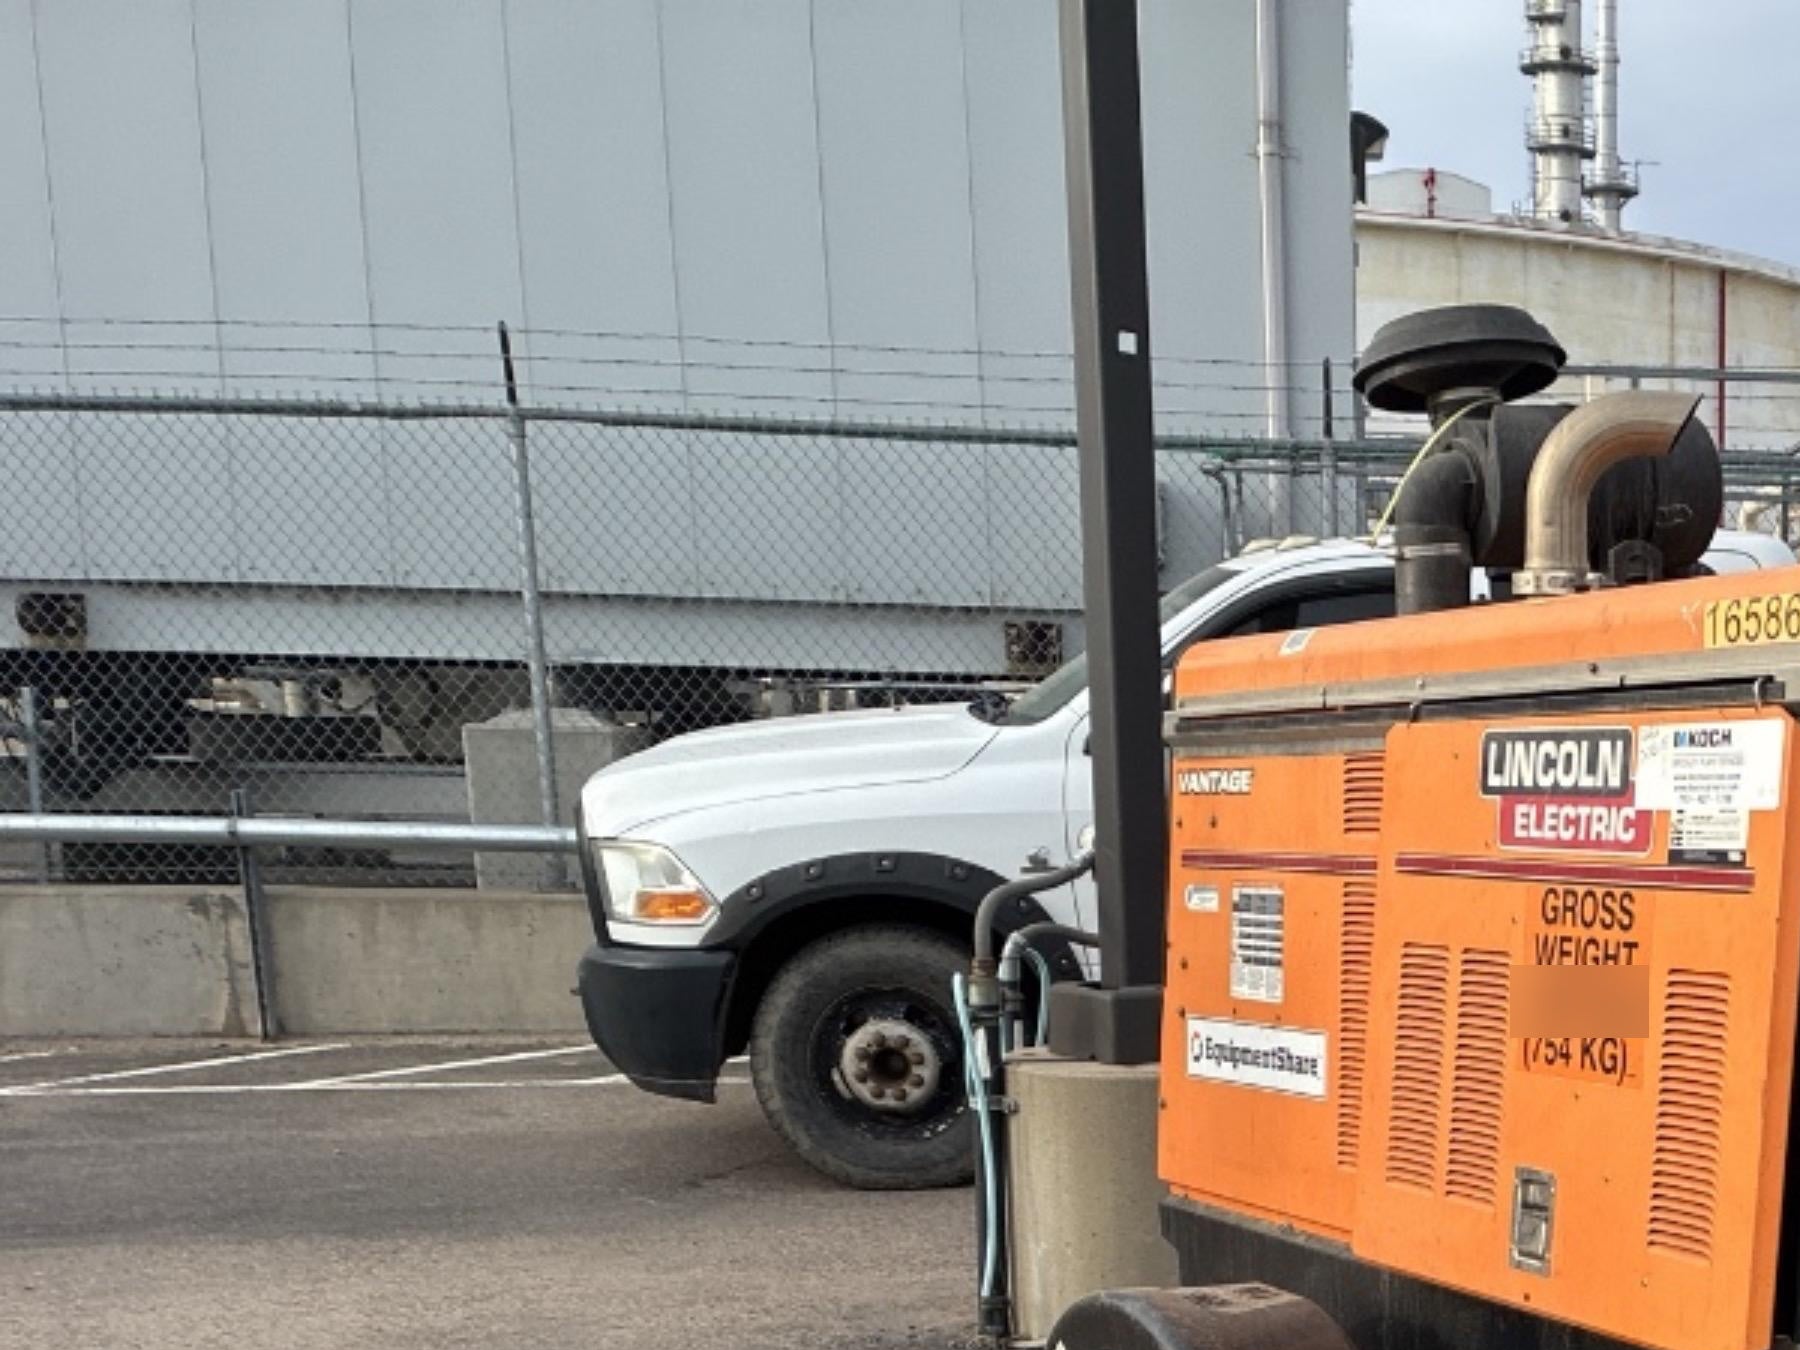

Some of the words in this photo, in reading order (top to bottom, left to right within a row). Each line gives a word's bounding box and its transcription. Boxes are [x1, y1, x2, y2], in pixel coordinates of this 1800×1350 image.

[1178, 769, 1253, 794] VANTAGE
[1487, 740, 1624, 788] LINCOLN
[1514, 803, 1636, 843] ELECTRIC
[1541, 887, 1635, 931] GROSS
[1535, 933, 1639, 965] WEIGHT
[1206, 1037, 1319, 1078] EquipmentShare
[1580, 1038, 1627, 1086] KG)
